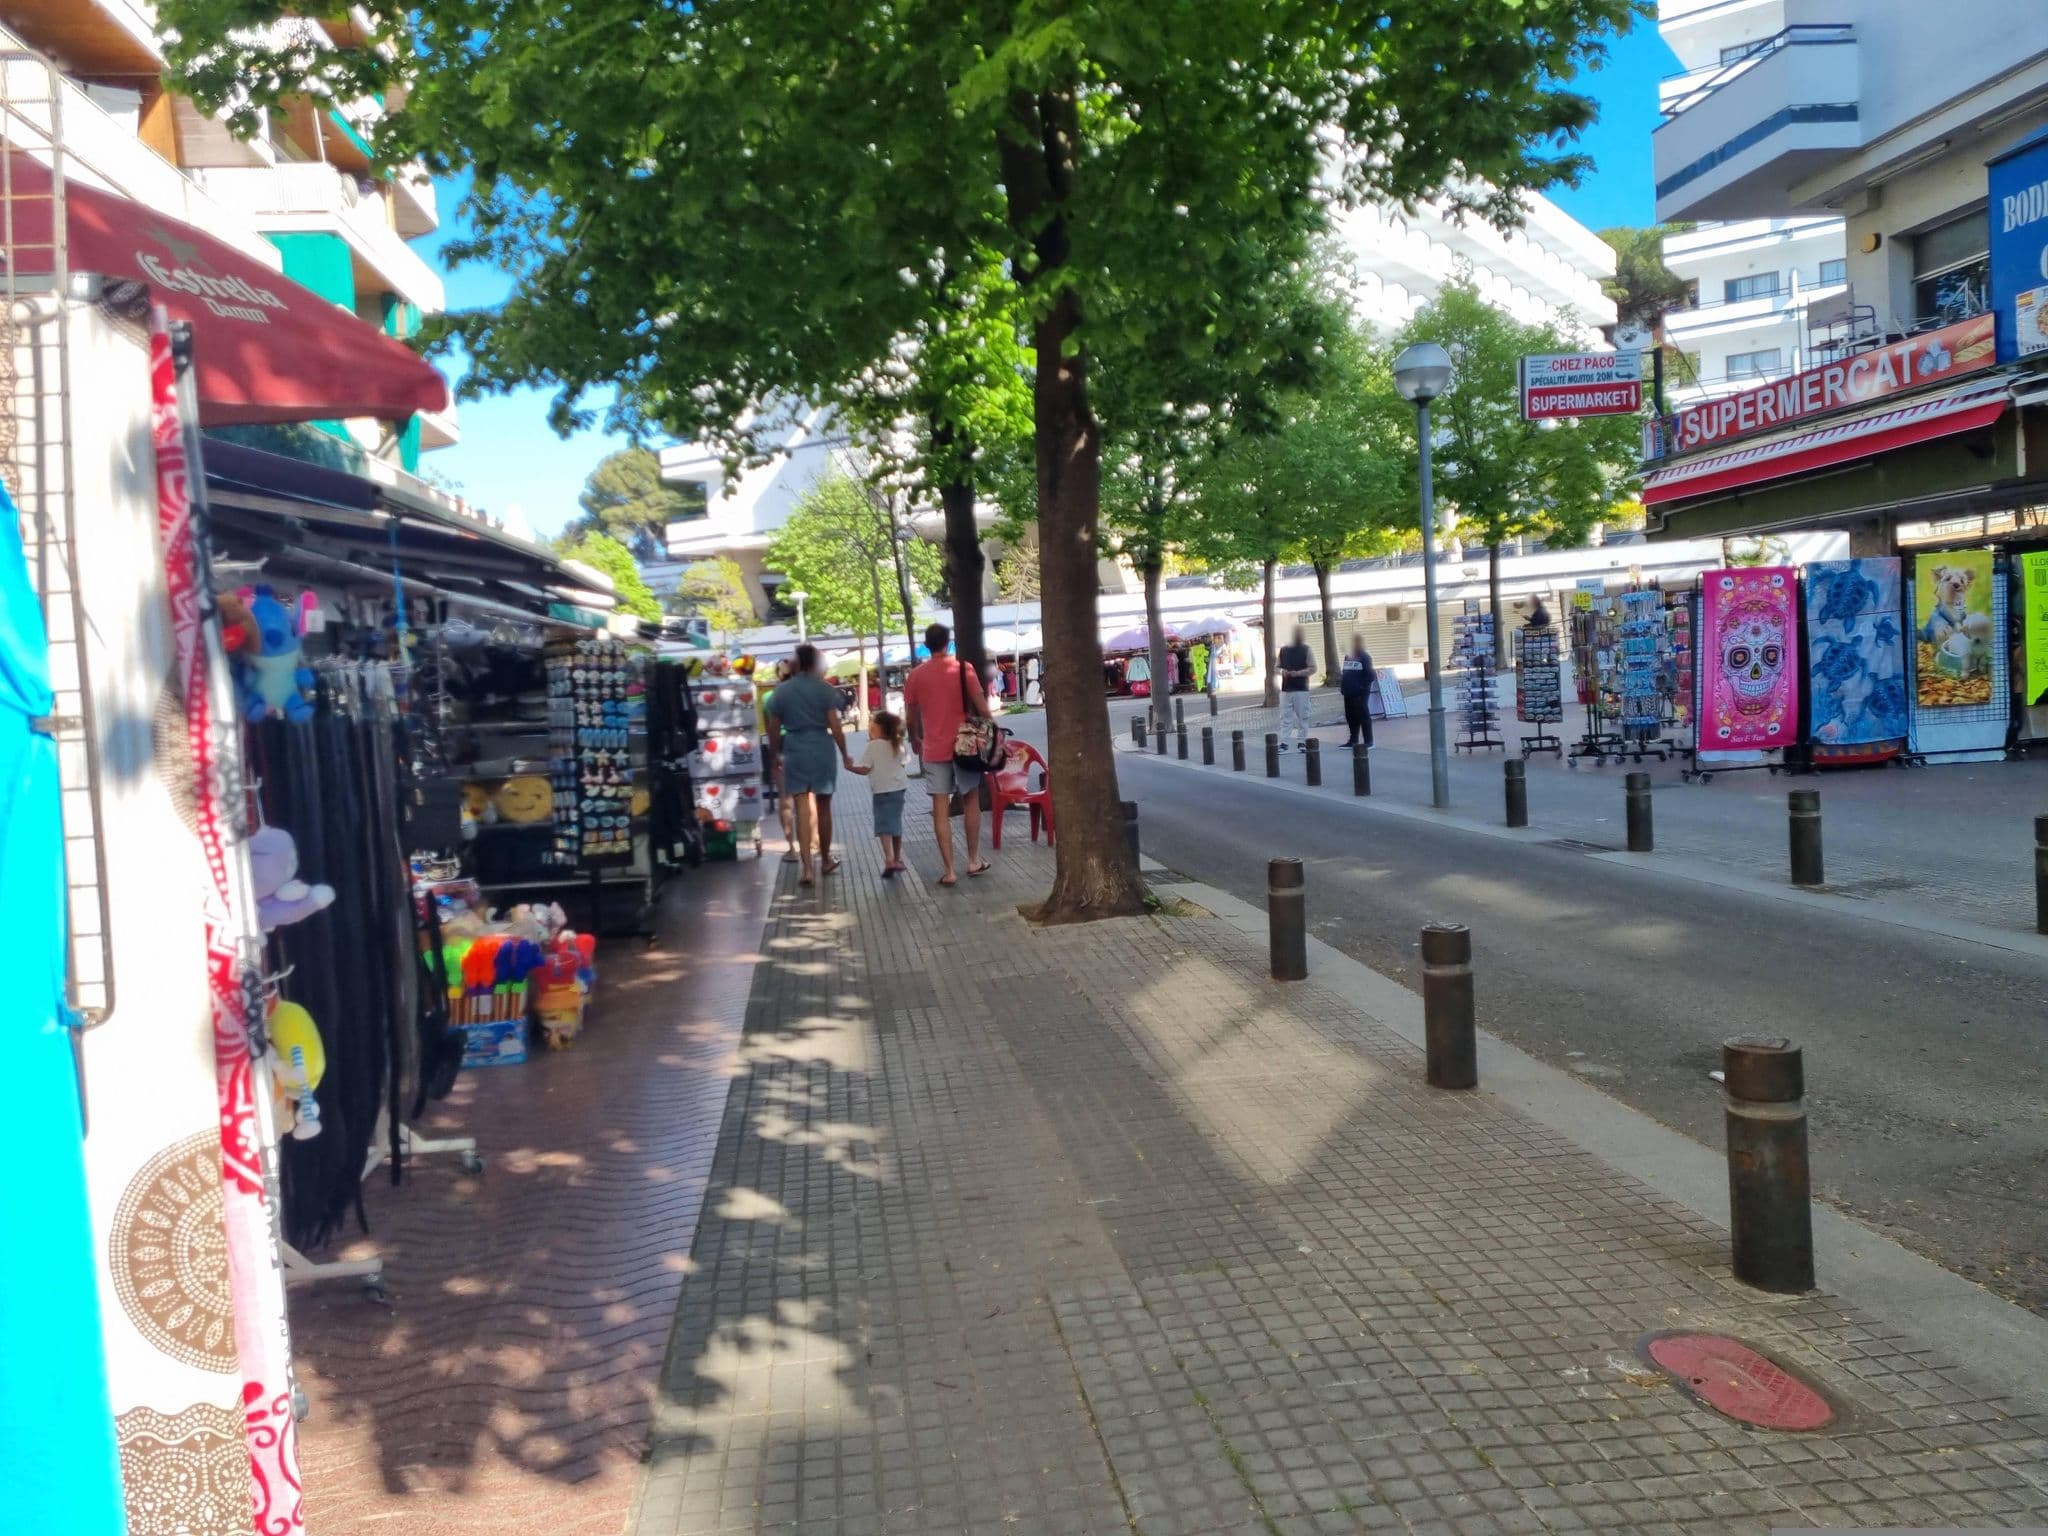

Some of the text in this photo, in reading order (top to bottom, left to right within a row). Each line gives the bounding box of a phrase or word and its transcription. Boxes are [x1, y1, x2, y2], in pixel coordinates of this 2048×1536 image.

[136, 250, 288, 310] Estrella
[201, 297, 271, 323] Damm
[1552, 359, 1581, 372] CHEZ
[1584, 356, 1615, 369] PACO
[1532, 390, 1629, 412] SUPERMARKET
[1685, 338, 1919, 445] SUPERMERCAT
